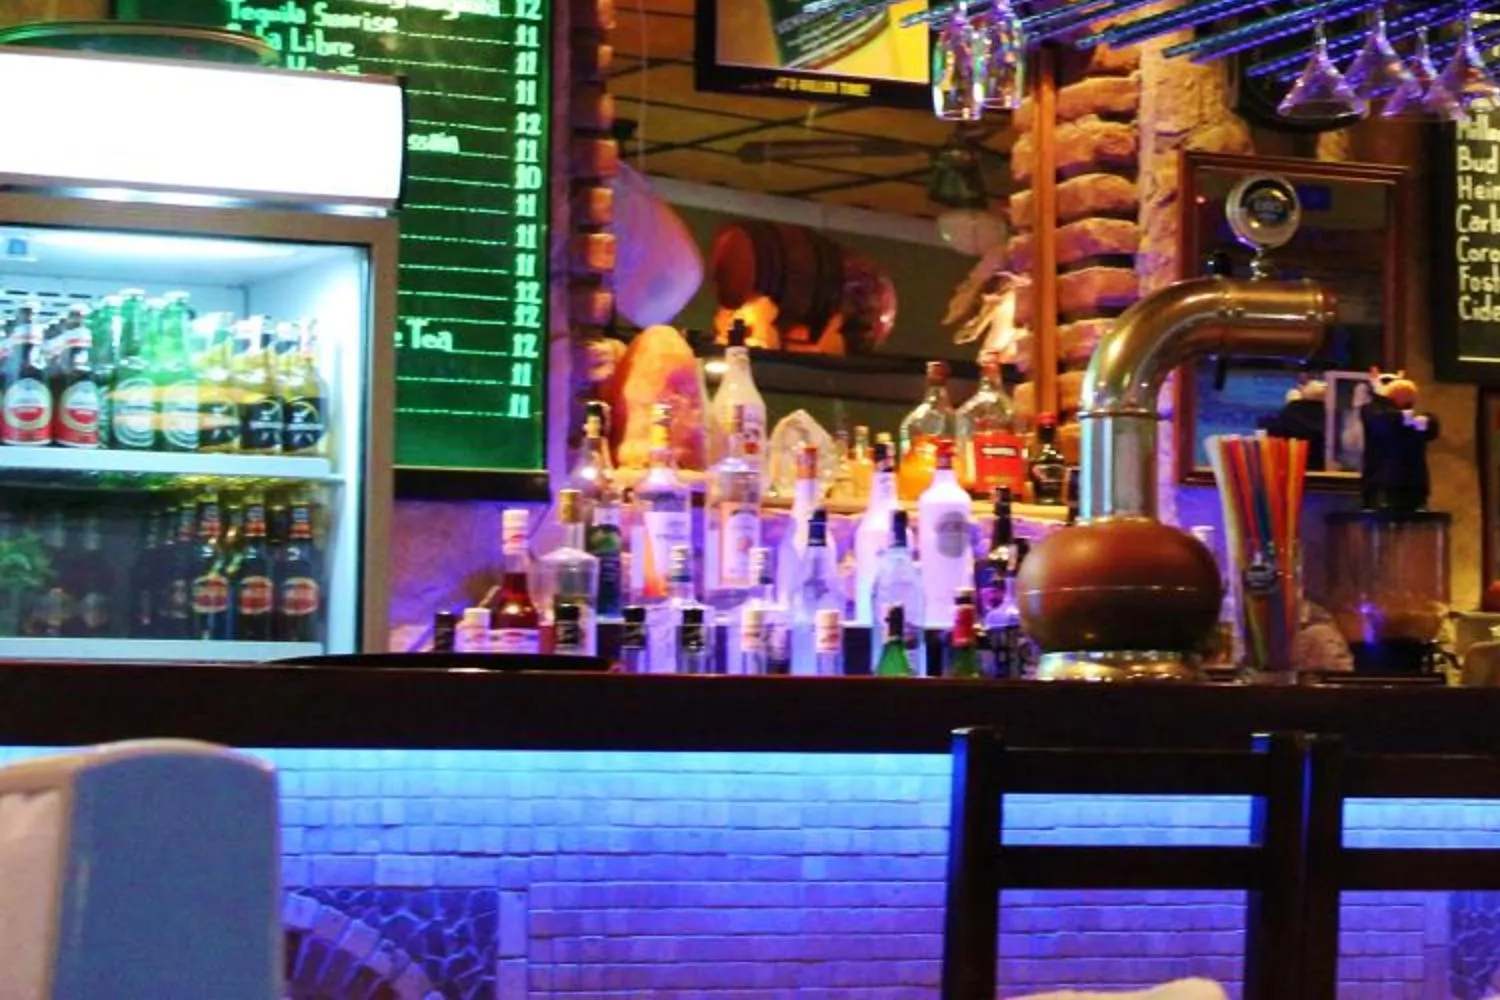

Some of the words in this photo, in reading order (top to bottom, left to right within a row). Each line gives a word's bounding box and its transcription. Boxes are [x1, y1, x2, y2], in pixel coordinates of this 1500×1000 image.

[313, 2, 399, 33] Sunrise
[289, 27, 354, 57] Libre
[515, 51, 537, 75] 11
[1457, 145, 1499, 174] Bud
[515, 164, 542, 189] 10
[406, 317, 453, 352] Tea
[512, 333, 539, 358] 12
